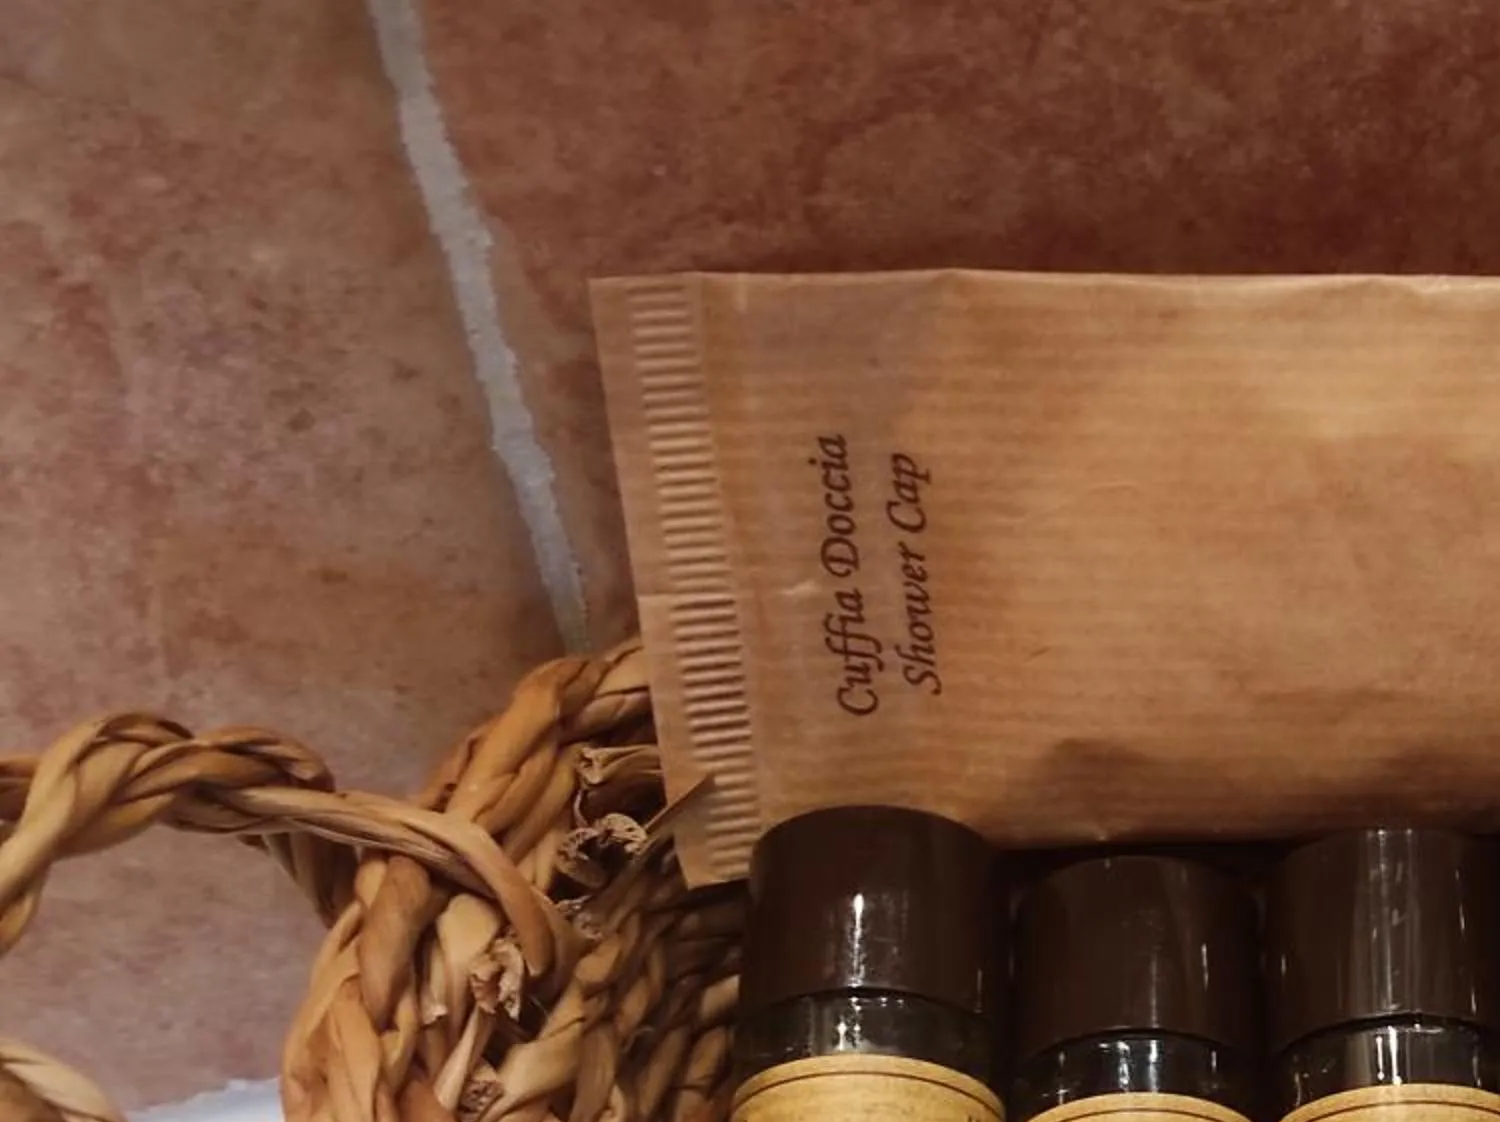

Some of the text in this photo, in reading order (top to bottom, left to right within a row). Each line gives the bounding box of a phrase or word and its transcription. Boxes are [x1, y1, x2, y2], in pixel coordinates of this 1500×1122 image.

[808, 434, 884, 716] Cuffia Doccia
[886, 453, 942, 696] Shower Cap
